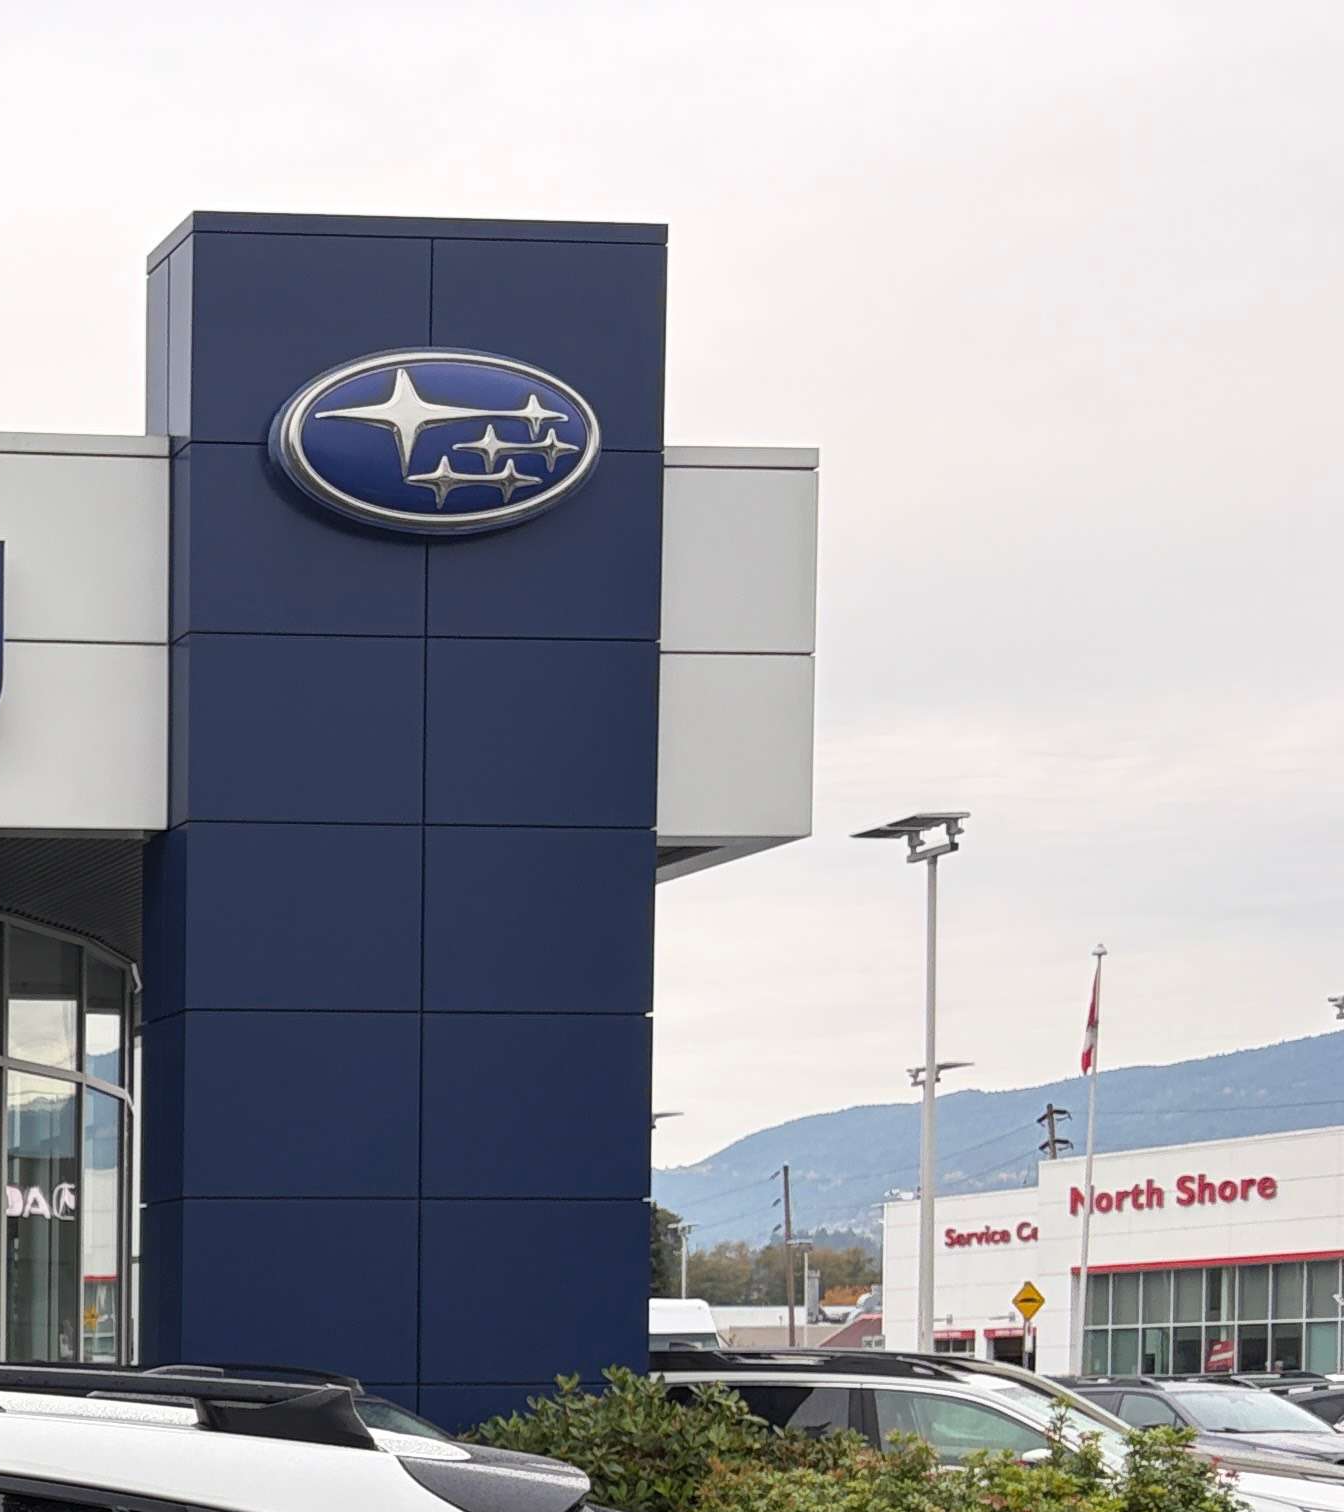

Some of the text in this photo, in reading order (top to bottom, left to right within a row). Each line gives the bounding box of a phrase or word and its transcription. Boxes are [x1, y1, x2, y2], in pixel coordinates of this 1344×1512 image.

[1069, 1174, 1279, 1216] North Shore
[944, 1225, 1011, 1248] Service
